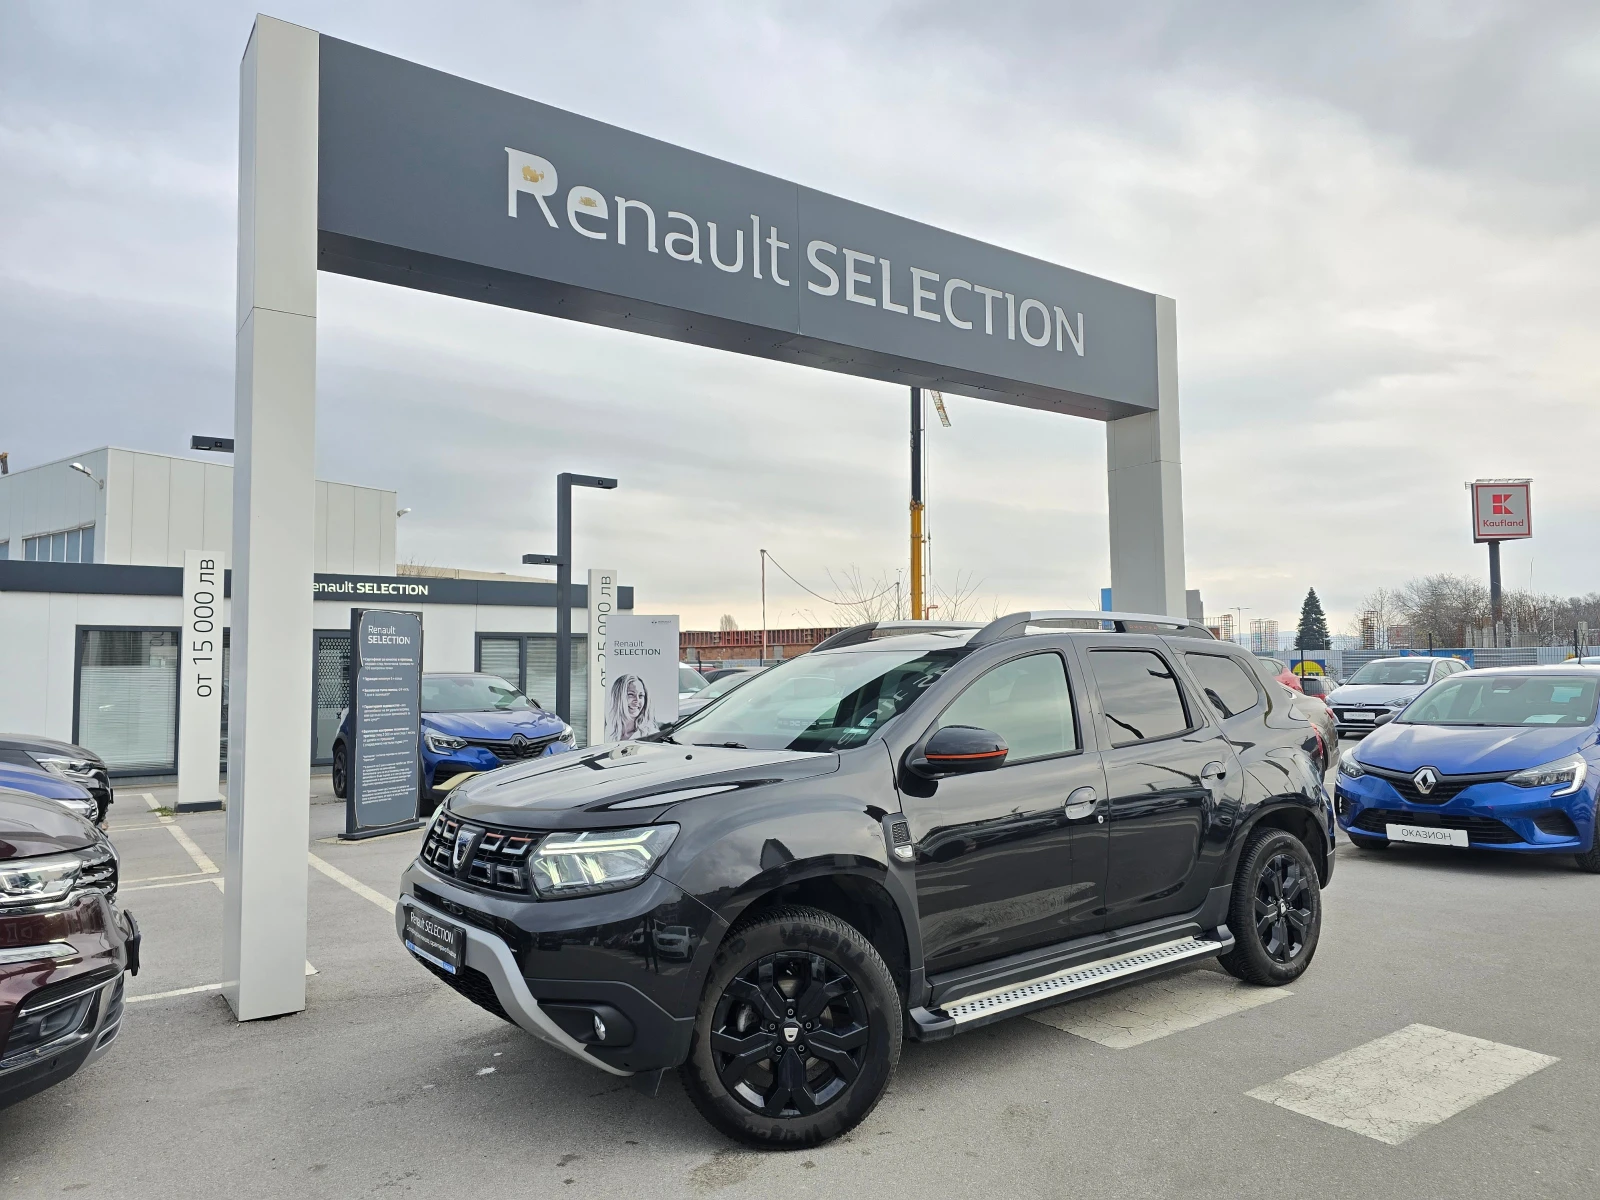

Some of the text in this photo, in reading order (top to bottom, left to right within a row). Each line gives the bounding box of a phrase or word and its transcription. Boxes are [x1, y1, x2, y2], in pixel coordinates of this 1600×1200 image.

[504, 147, 1085, 357] Renault SELECTION
[1483, 519, 1524, 527] Kaufland
[313, 580, 429, 596] enault SELECTION
[193, 591, 215, 633] 000
[368, 625, 396, 635] Renault
[367, 635, 411, 645] SELECTION
[614, 640, 644, 648] Renault
[192, 640, 213, 665] 15
[614, 648, 661, 656] SELECTION
[1401, 828, 1452, 841] ОКАЗИОН
[410, 911, 426, 931] Renault
[424, 920, 454, 945] SELECTION
